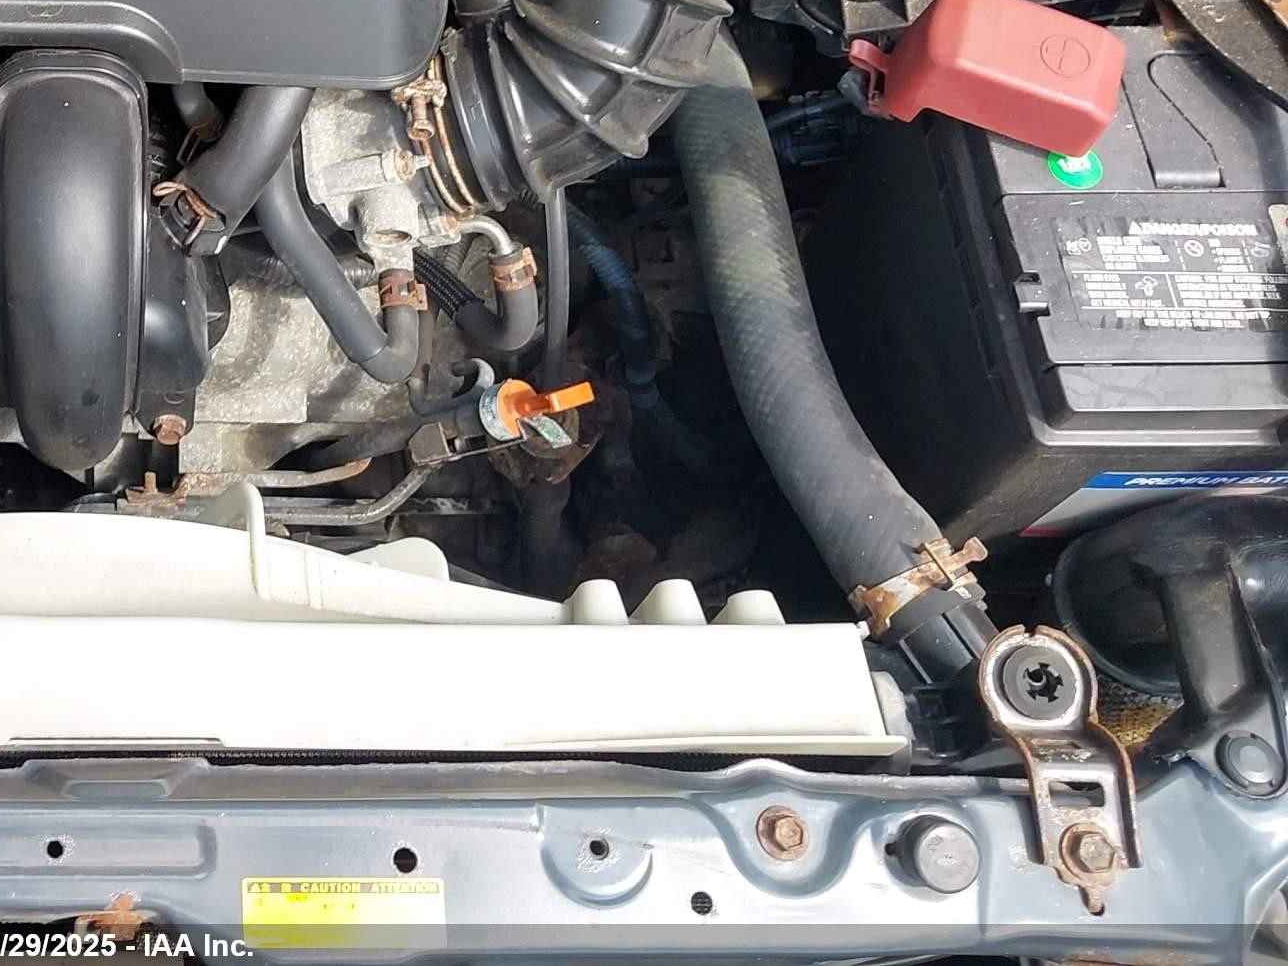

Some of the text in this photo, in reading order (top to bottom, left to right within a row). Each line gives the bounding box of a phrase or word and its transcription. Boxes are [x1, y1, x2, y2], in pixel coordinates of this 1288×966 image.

[1123, 476, 1239, 487] PREMIUM
[300, 882, 361, 894] CAUTION
[370, 882, 439, 894] ATTENTION
